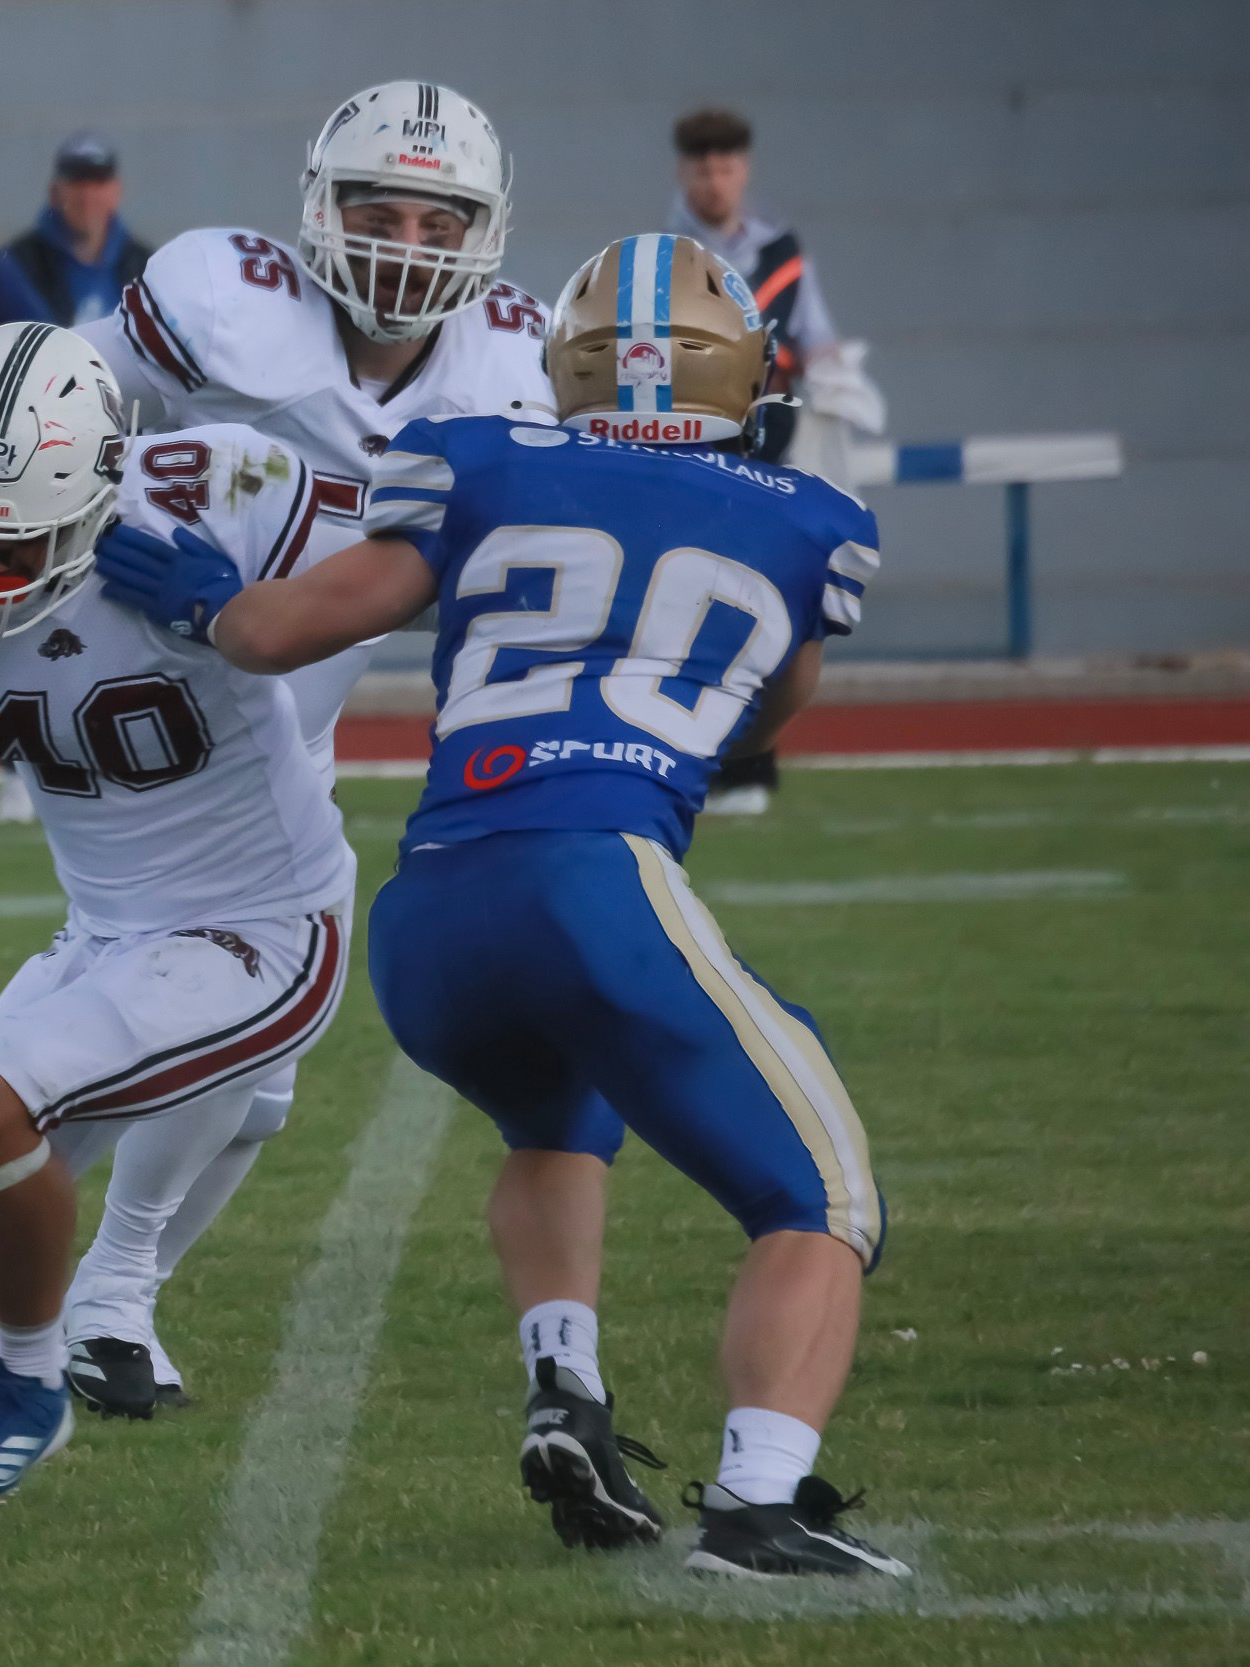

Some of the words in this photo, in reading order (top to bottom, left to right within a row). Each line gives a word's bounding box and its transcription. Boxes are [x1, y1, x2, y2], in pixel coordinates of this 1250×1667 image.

[402, 119, 446, 141] MPI
[398, 153, 441, 170] Riddell
[590, 419, 702, 441] Riddell
[140, 439, 214, 526] 40
[434, 524, 793, 759] 20
[528, 740, 677, 779] SPURT
